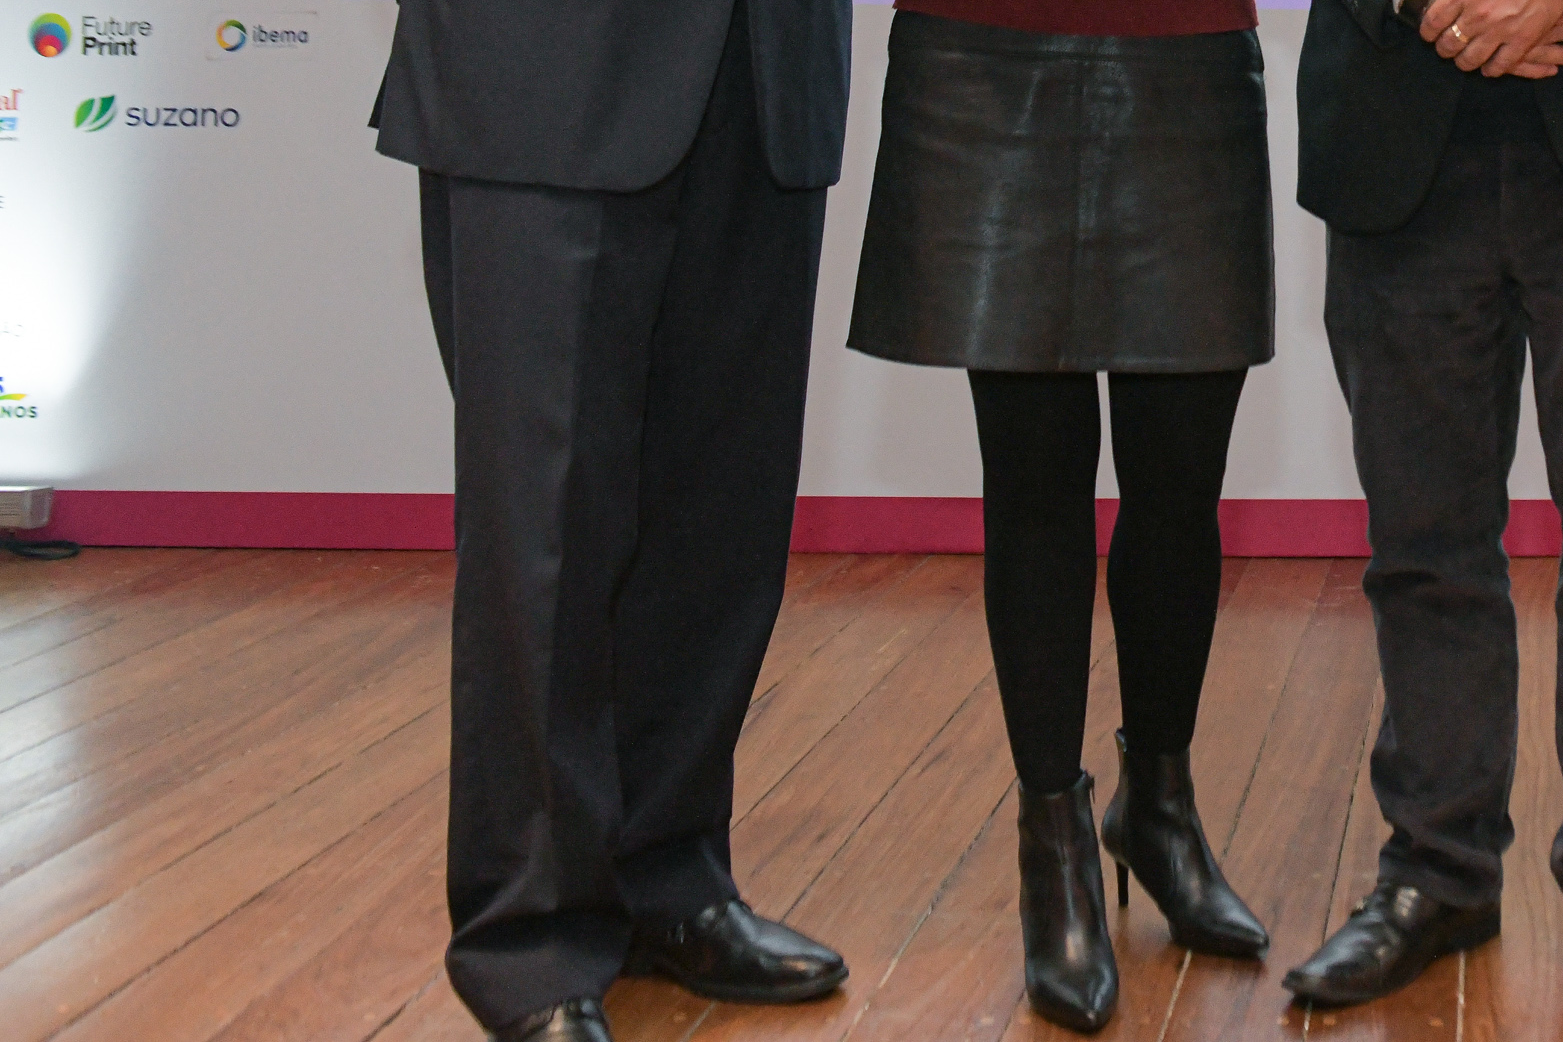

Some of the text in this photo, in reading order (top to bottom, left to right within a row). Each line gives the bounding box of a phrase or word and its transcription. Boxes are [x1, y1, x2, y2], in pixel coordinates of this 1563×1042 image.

[81, 15, 153, 37] Future
[252, 24, 309, 44] ibema
[81, 37, 138, 57] Print
[125, 106, 240, 128] suzano
